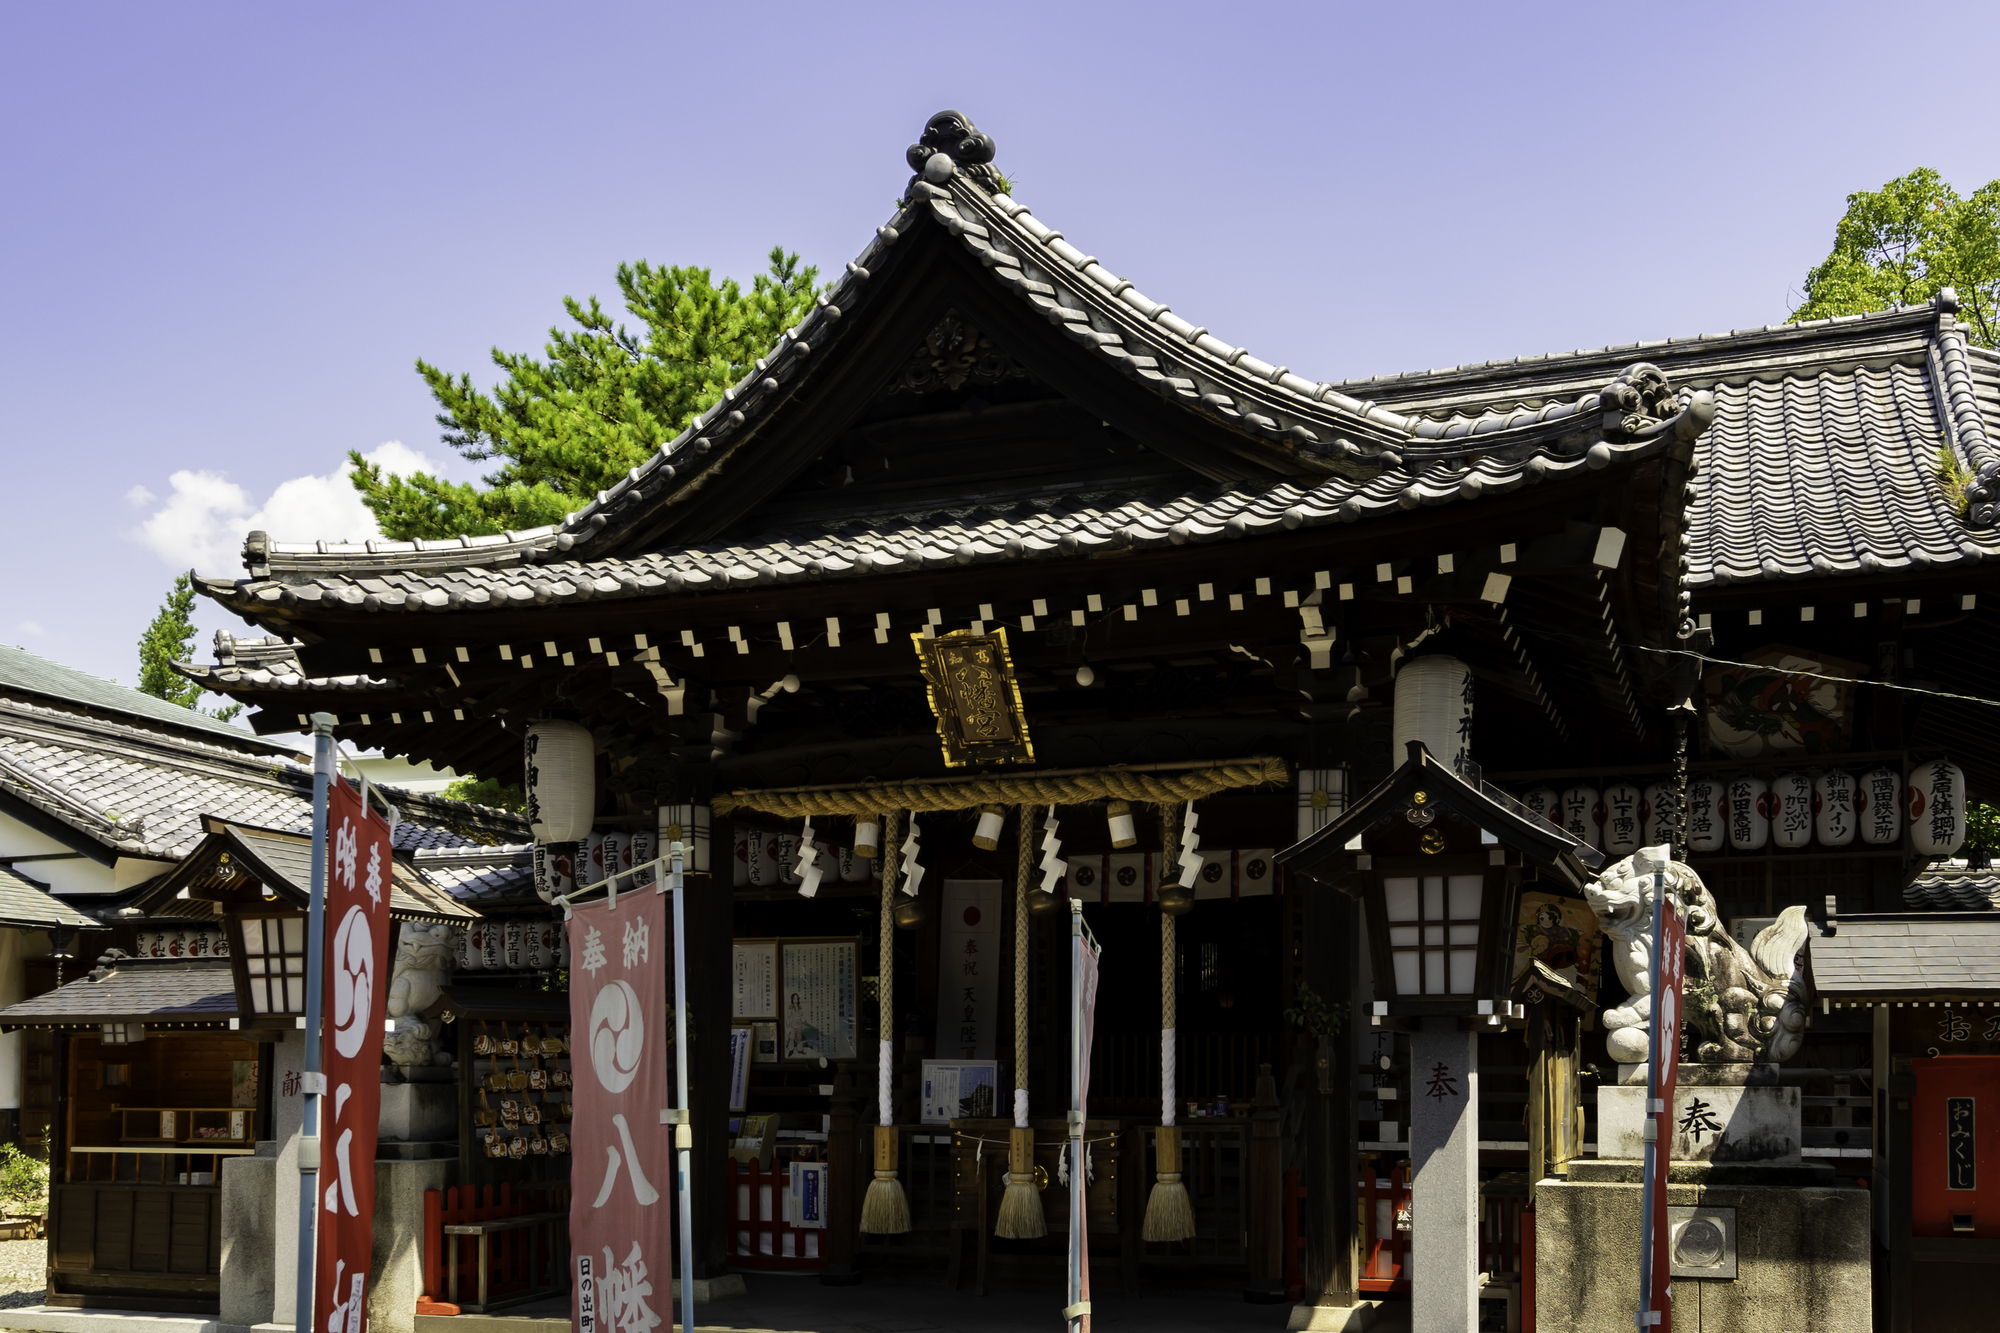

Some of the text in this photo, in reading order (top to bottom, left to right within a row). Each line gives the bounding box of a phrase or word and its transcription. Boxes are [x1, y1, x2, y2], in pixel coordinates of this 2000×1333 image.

[1612, 787, 1635, 846] 山下陽三
[1690, 784, 1713, 842] 柳野浩一
[1784, 794, 1798, 841] カンパニー
[1826, 773, 1850, 838] 新堀ハイツ
[962, 938, 979, 977] 奉祝
[1425, 1061, 1459, 1104] 奉
[1678, 1097, 1722, 1144] 奉
[1951, 1100, 1972, 1187] おみくじ
